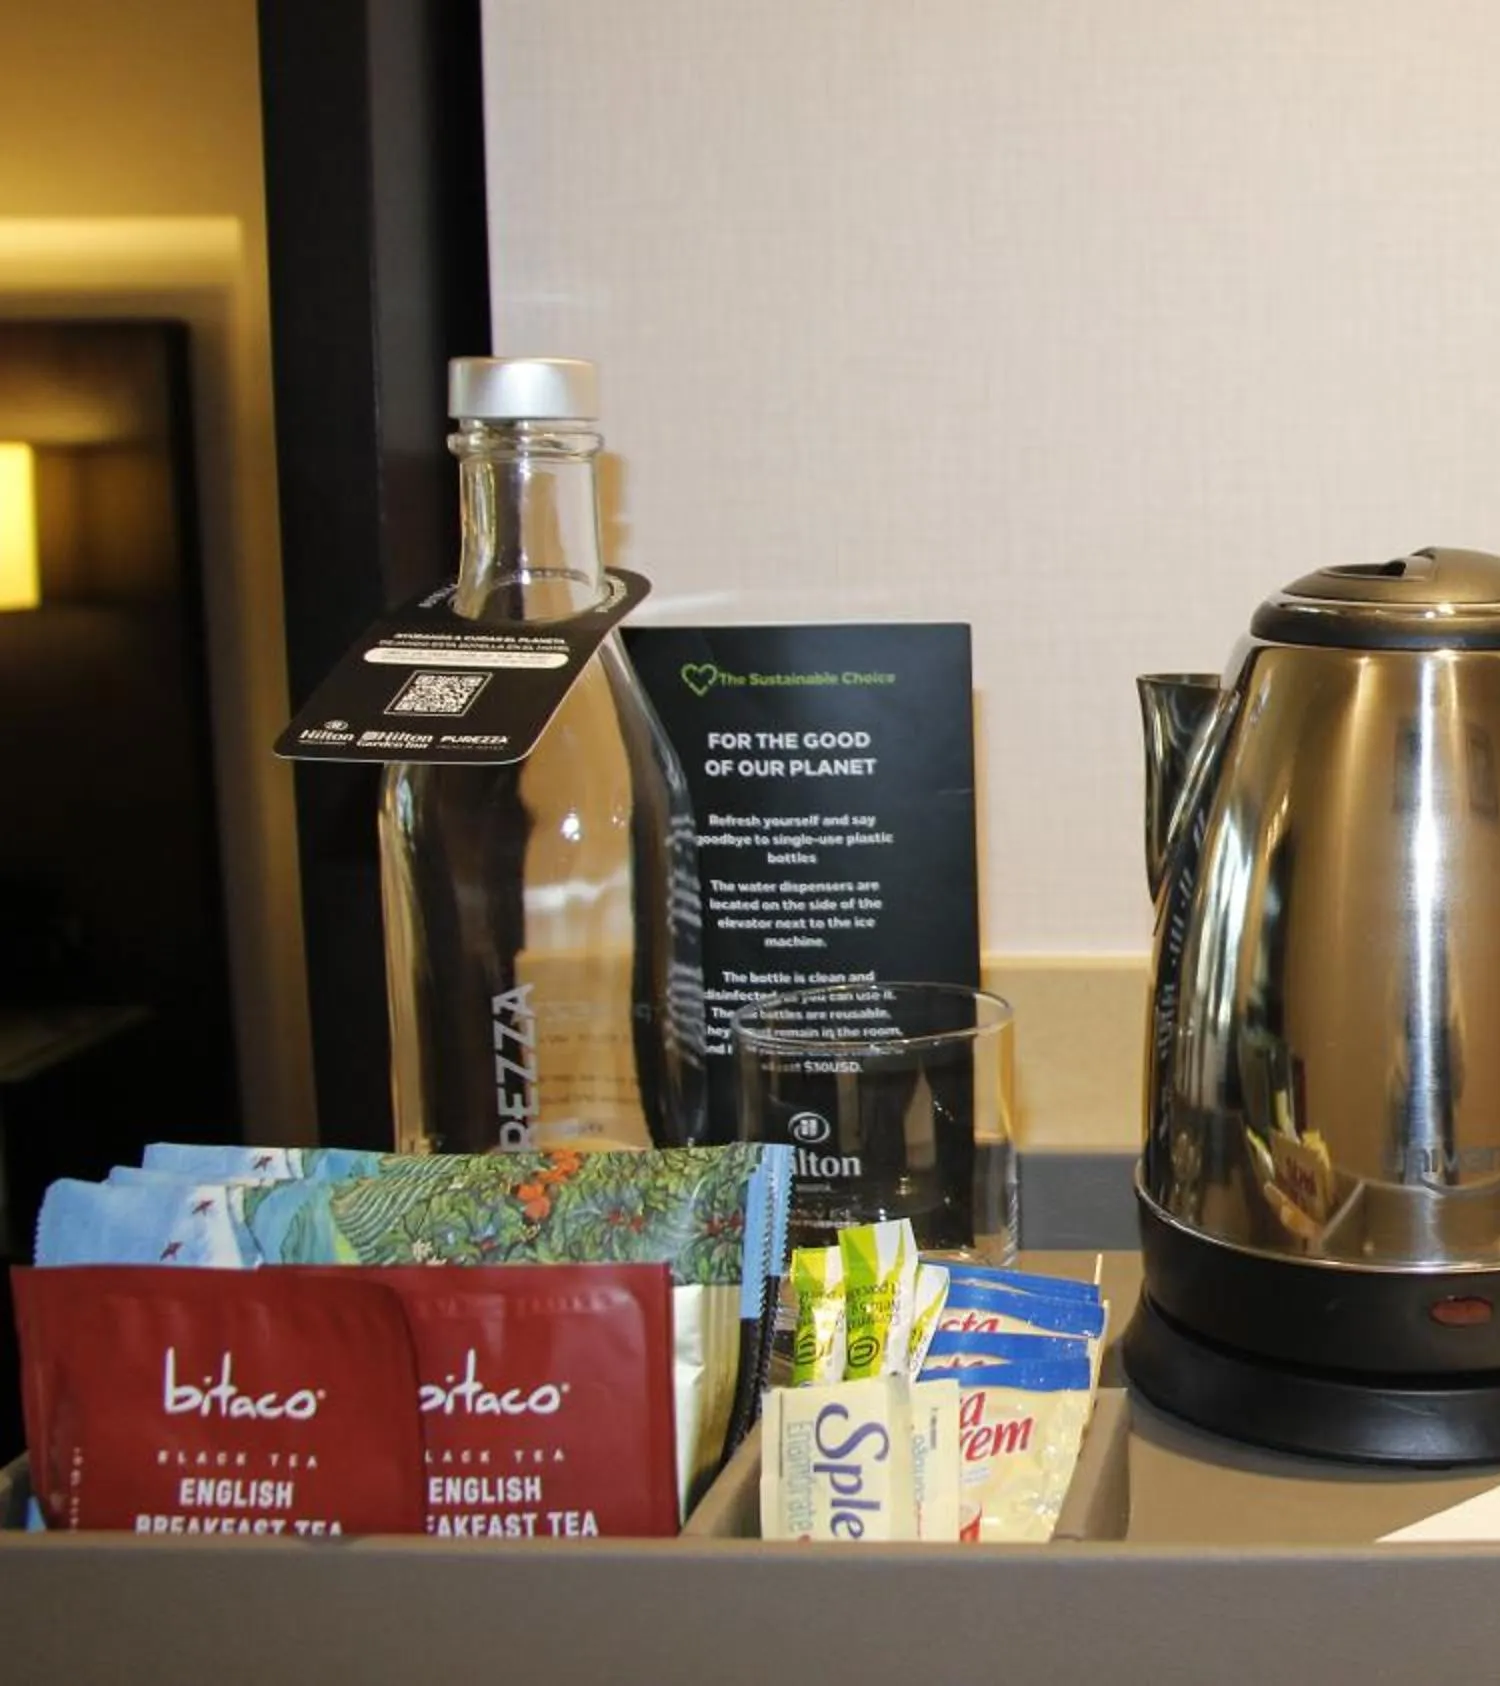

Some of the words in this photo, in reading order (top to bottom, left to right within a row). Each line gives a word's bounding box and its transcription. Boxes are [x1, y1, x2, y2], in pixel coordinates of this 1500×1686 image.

[719, 672, 746, 685] The
[749, 671, 839, 686] Sustainable
[842, 671, 896, 685] Choice
[708, 733, 751, 750] FOR
[756, 732, 798, 750] THE
[803, 731, 871, 749] GOOD
[705, 760, 734, 776] OF
[738, 760, 785, 776] OUR
[789, 758, 877, 776] PLANET
[709, 815, 760, 827] Refresh
[764, 815, 820, 829] yourself
[823, 815, 849, 826] and
[852, 816, 876, 829] say
[754, 834, 769, 845] to
[773, 834, 843, 848] single-use
[847, 832, 894, 847] plastic
[768, 852, 816, 864] bottles
[711, 880, 735, 892] The
[738, 882, 776, 892] water
[780, 880, 853, 895] dispensers
[857, 881, 879, 891] are
[710, 900, 759, 911] located
[762, 902, 780, 911] on
[783, 900, 806, 910] the
[809, 900, 837, 910] side
[840, 899, 856, 909] of
[858, 898, 882, 909] the
[718, 918, 772, 928] elevator
[776, 918, 806, 928] next
[810, 918, 825, 928] to
[828, 917, 851, 928] the
[855, 917, 875, 927] ice
[765, 936, 827, 947] machine.
[722, 972, 748, 983] The
[751, 971, 791, 983] bottle
[794, 972, 806, 982] is
[808, 971, 845, 982] clean
[848, 971, 875, 982] and
[829, 991, 853, 1001] can
[856, 991, 880, 1000] use
[805, 1010, 826, 1019] are
[830, 1008, 892, 1019] reusable.
[706, 1025, 730, 1038] hey
[774, 1027, 820, 1037] remain
[836, 1026, 860, 1036] the
[491, 983, 539, 1151] REZZA
[797, 1149, 861, 1177] lton
[164, 1346, 317, 1419] bitaco
[158, 1450, 247, 1466] BLACK
[270, 1453, 317, 1468] TEA
[424, 1449, 491, 1463] LACK
[515, 1448, 564, 1463] TEA
[180, 1478, 294, 1508] ENGLISH
[428, 1475, 542, 1504] ENGLISH
[547, 1510, 599, 1537] TEA
